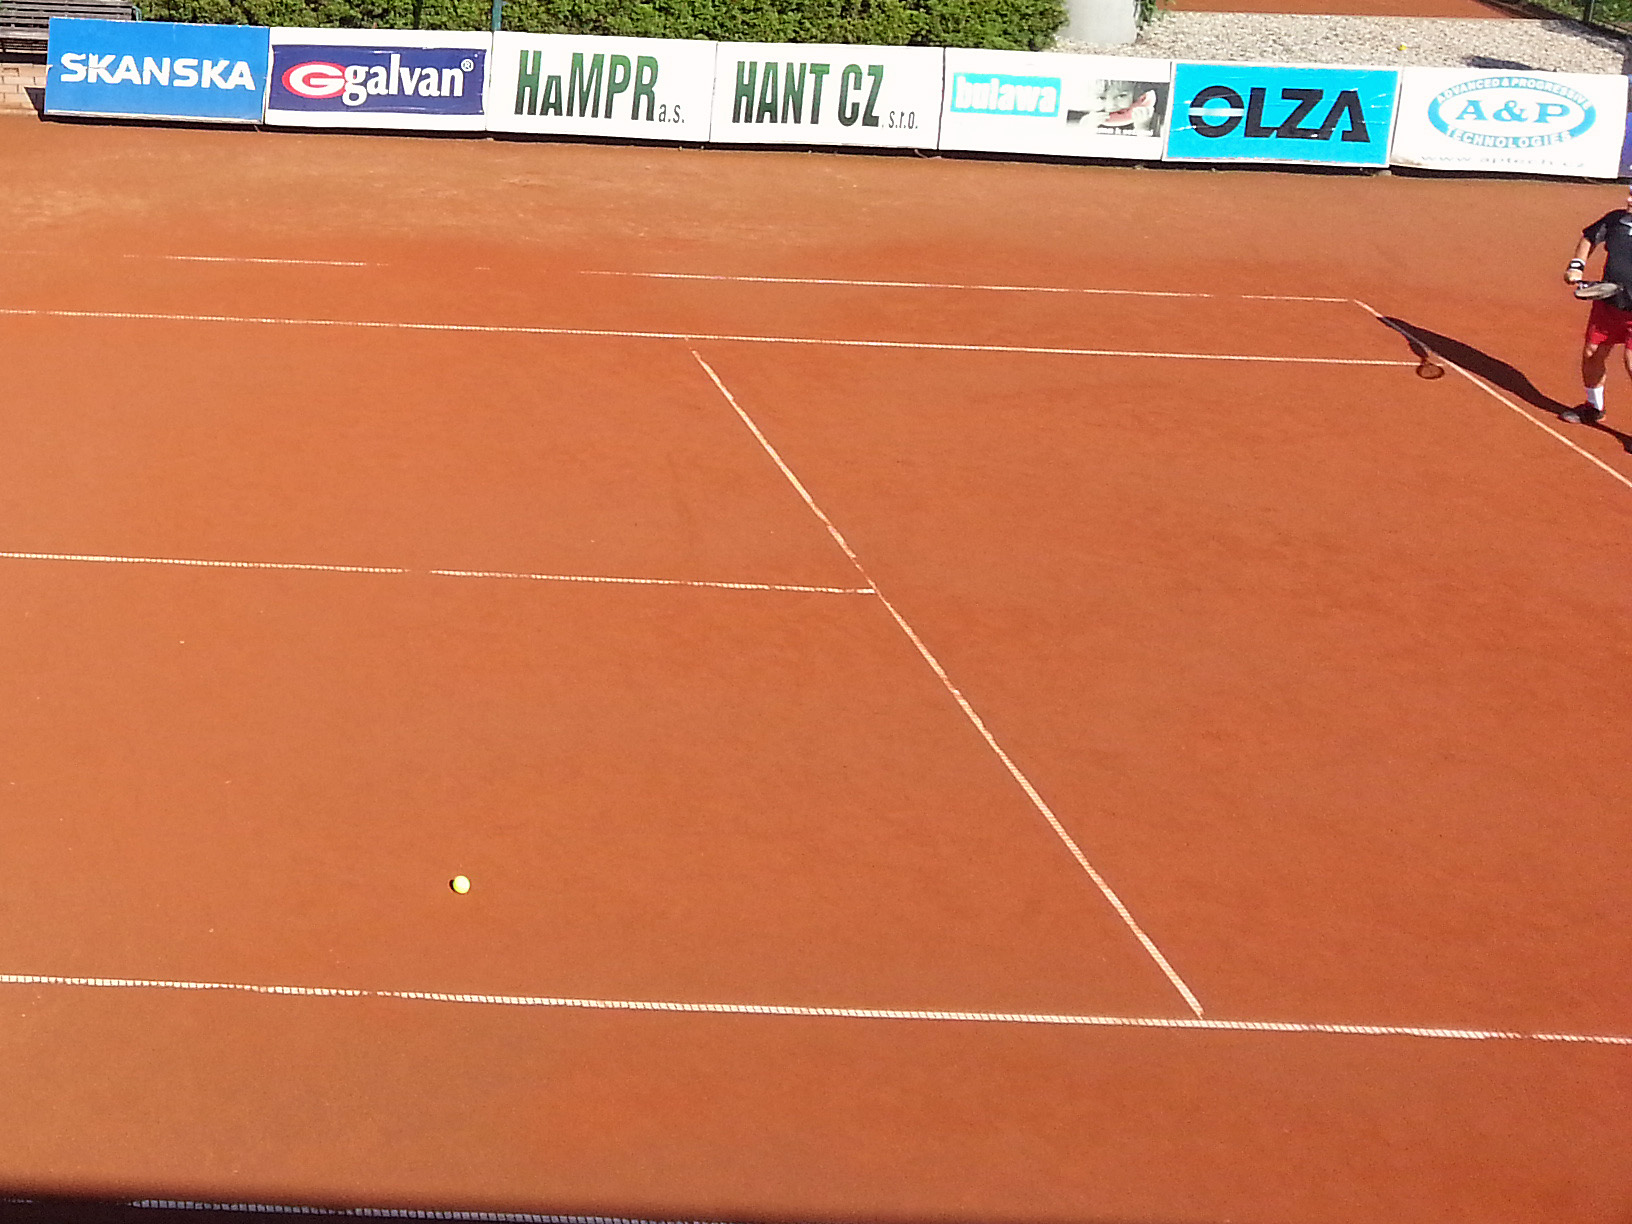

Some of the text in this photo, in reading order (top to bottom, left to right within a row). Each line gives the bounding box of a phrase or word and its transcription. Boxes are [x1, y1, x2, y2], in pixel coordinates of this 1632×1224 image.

[60, 52, 256, 91] SKANSKA
[731, 61, 831, 124] HANT
[888, 110, 918, 129] s.r.o.
[659, 103, 685, 124] a.s.
[1188, 85, 1370, 143] OLZA
